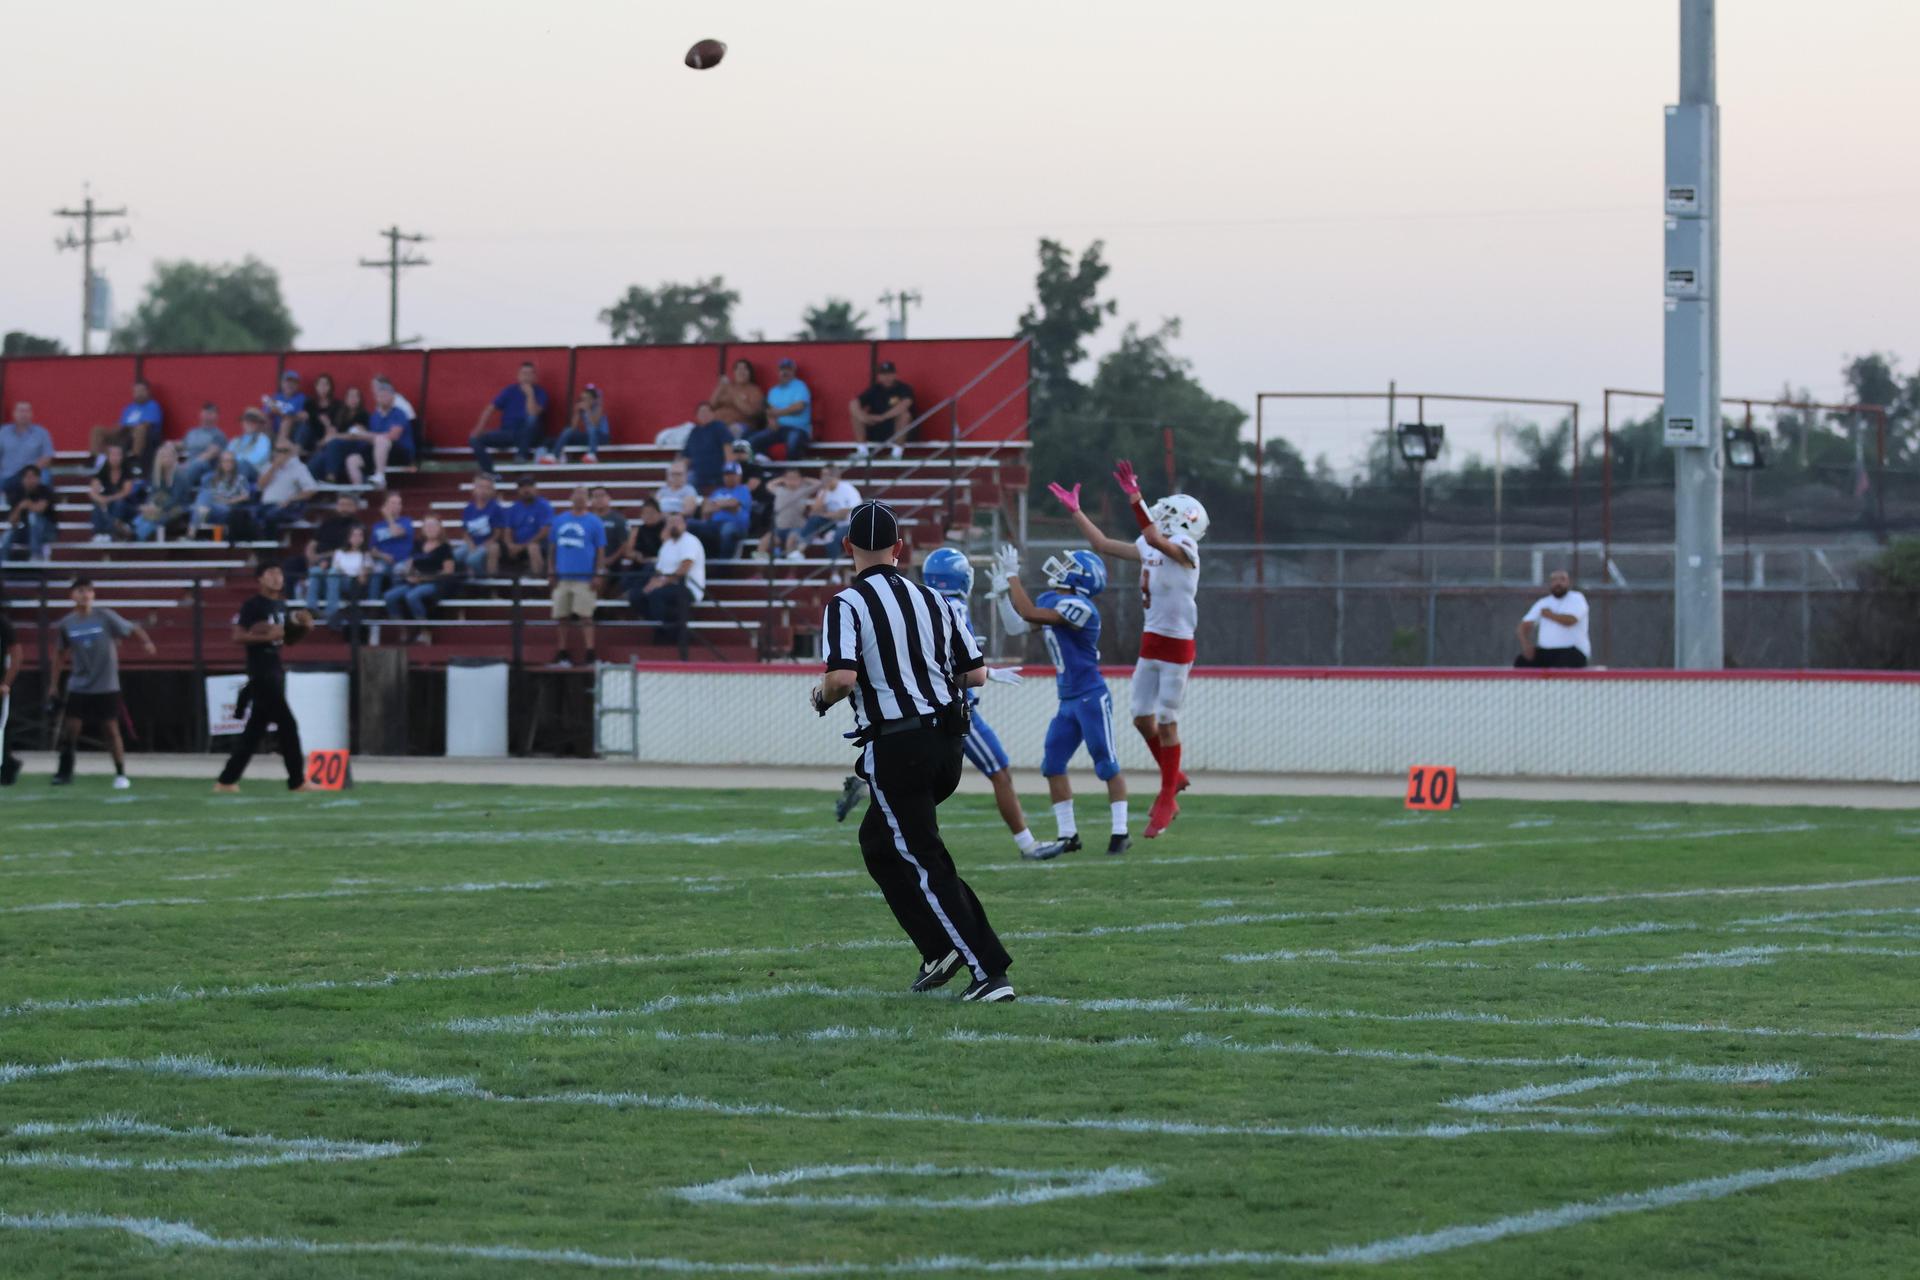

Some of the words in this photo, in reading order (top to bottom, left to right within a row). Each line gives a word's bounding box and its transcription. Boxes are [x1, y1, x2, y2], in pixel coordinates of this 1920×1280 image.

[1061, 602, 1084, 624] 10
[311, 754, 342, 784] 20
[1409, 769, 1448, 805] 10
